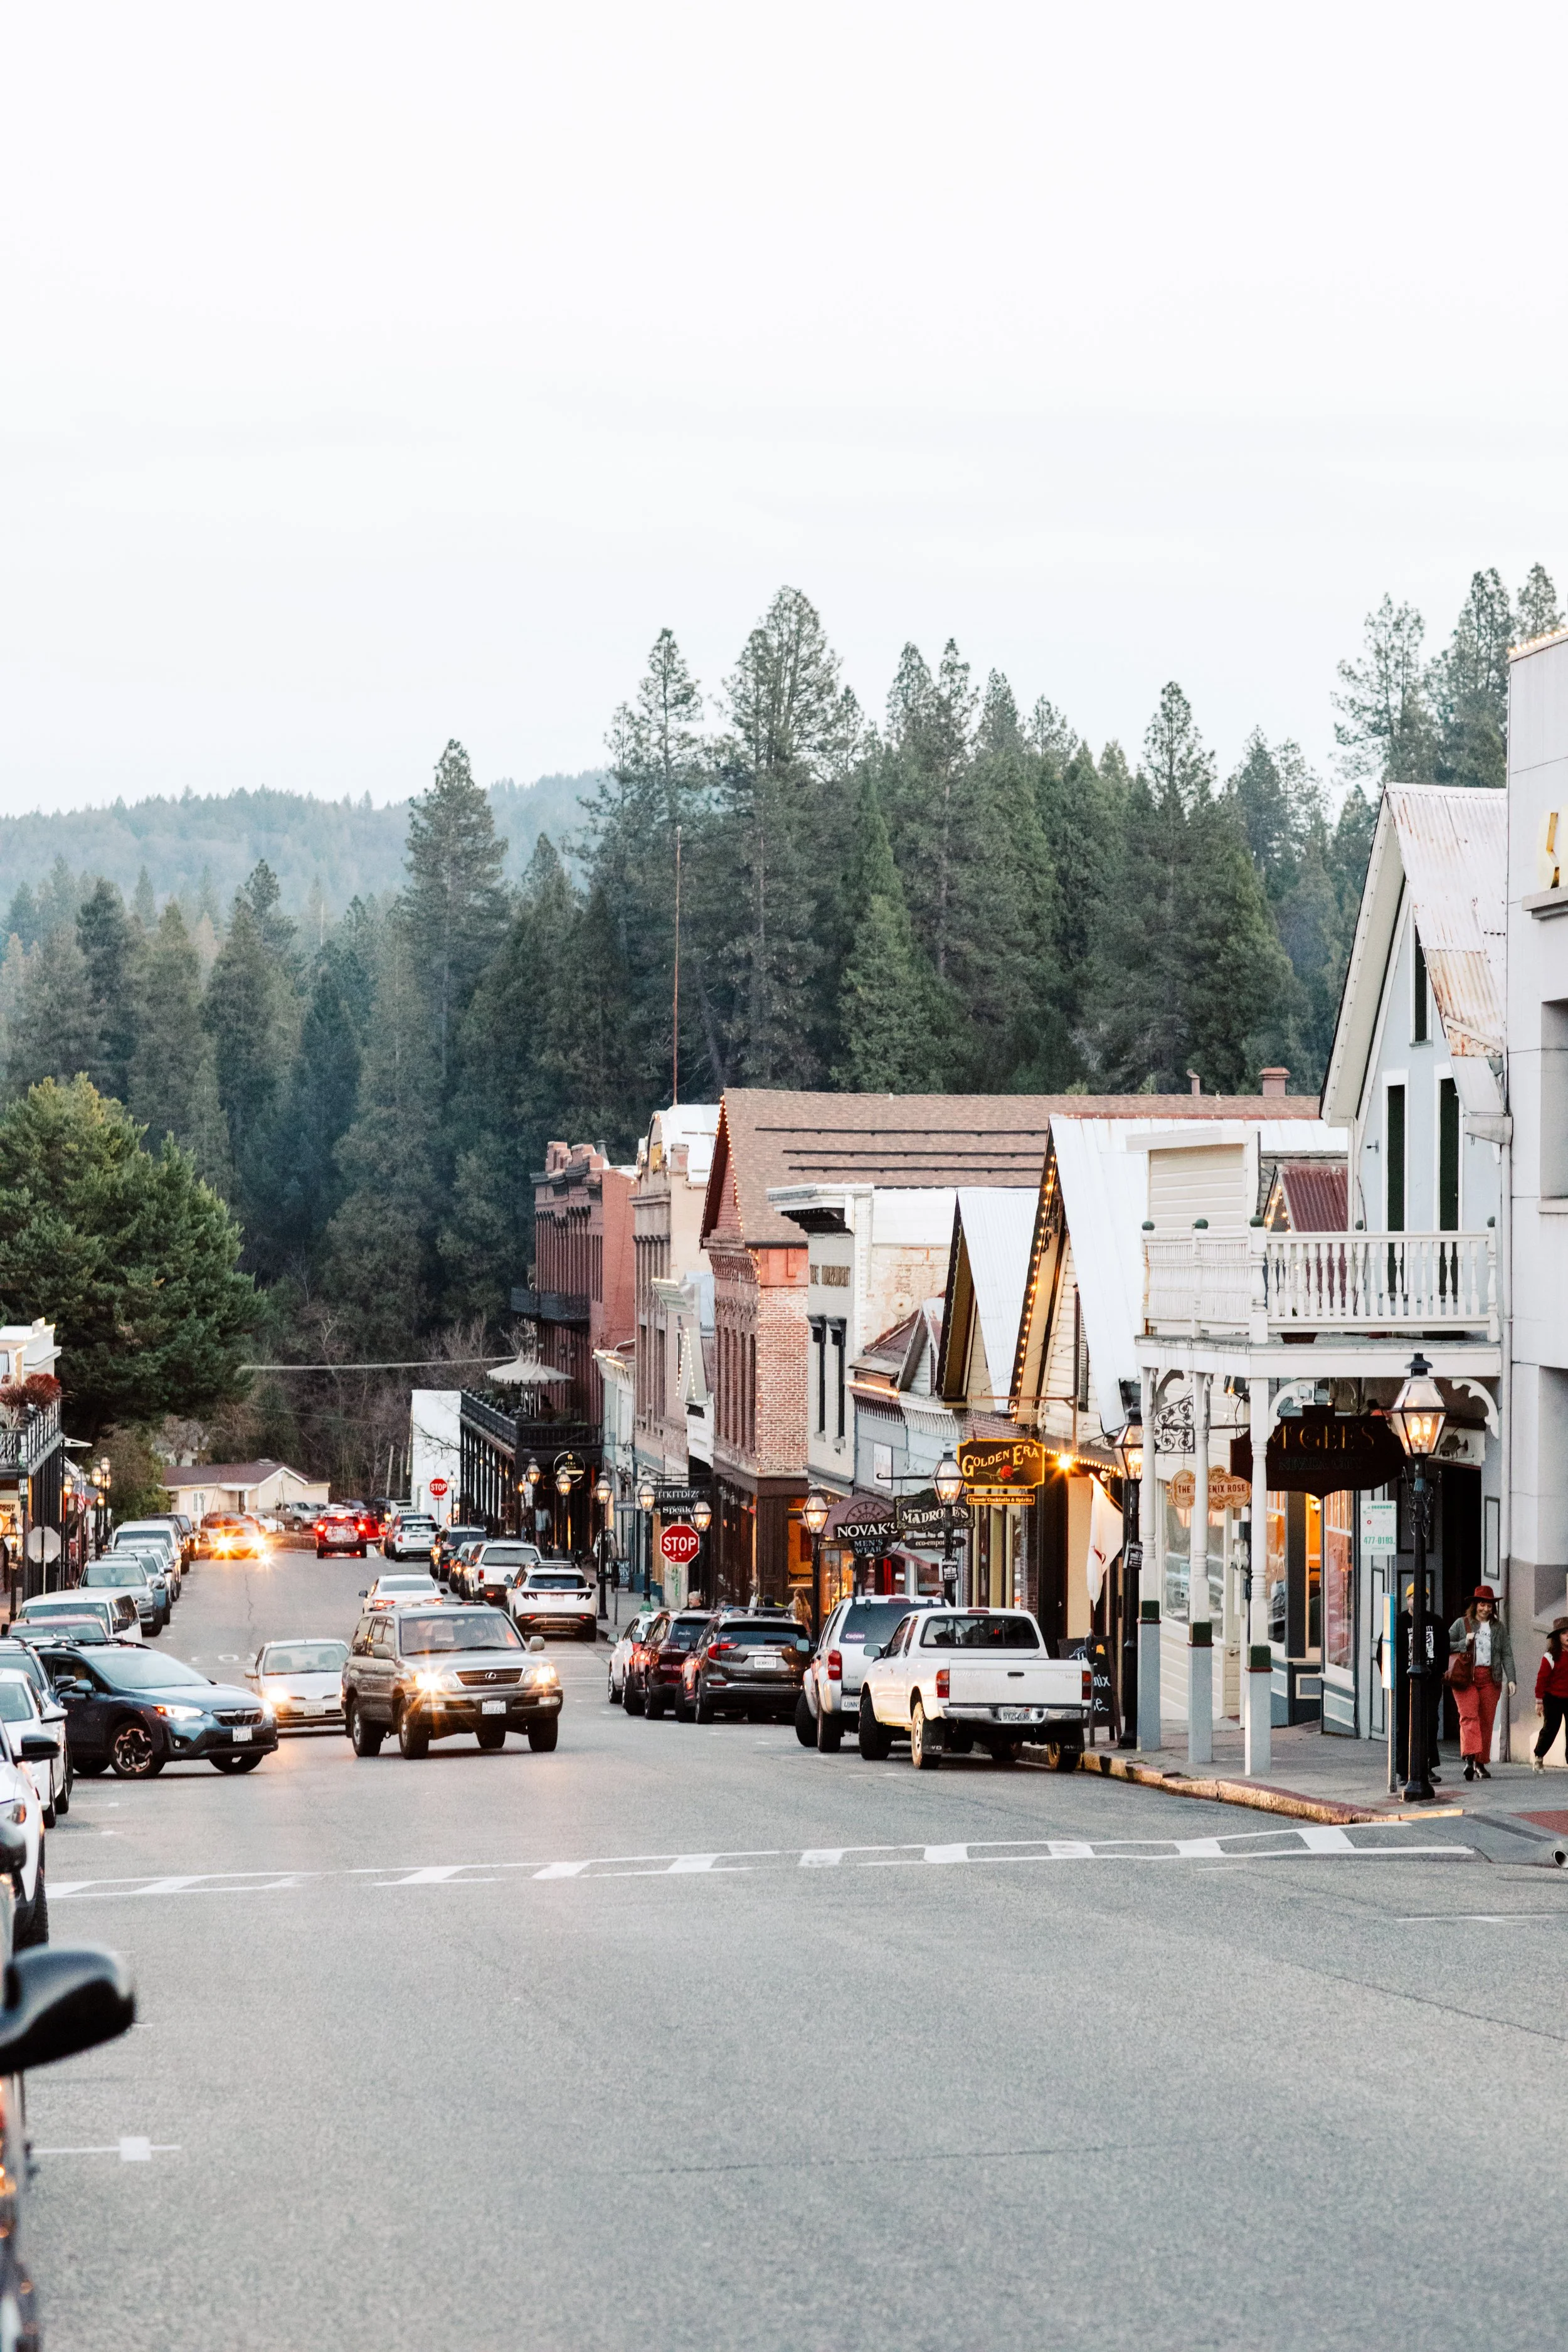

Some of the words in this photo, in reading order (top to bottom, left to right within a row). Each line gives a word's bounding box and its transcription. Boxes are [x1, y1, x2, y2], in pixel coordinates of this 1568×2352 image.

[961, 1449, 1010, 1477] GOLDEN
[1012, 1444, 1040, 1466] ERA
[430, 1483, 447, 1491] STOP
[1178, 1485, 1190, 1493] THE
[1227, 1484, 1246, 1492] ROSE
[902, 1506, 968, 1524] MADROE'S
[837, 1522, 898, 1538] NOVAK'S
[663, 1537, 697, 1552] STOP
[854, 1538, 883, 1547] MEN'S
[856, 1545, 881, 1554] WEAR
